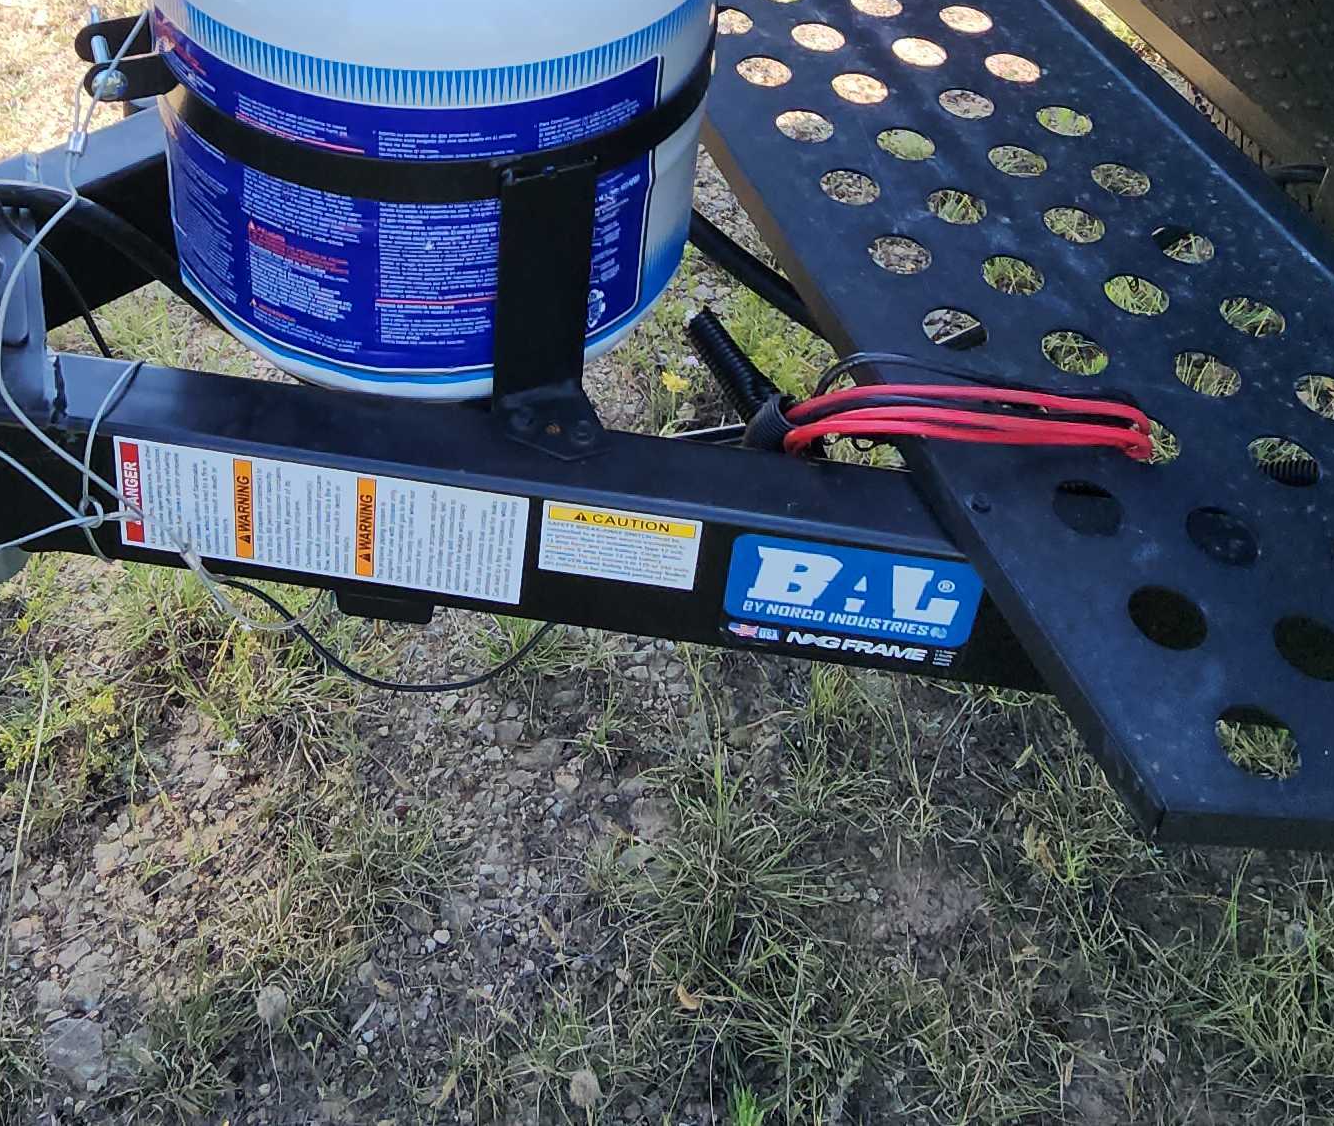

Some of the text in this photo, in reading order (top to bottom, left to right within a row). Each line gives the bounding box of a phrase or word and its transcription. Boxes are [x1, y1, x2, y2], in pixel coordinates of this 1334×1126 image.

[123, 461, 142, 517] ANGER
[236, 475, 250, 534] WARNING
[358, 494, 373, 553] WARNING
[592, 513, 671, 533] CAUTION
[742, 599, 930, 637] BY NORCO INDUSTRIES
[758, 627, 779, 641] USA
